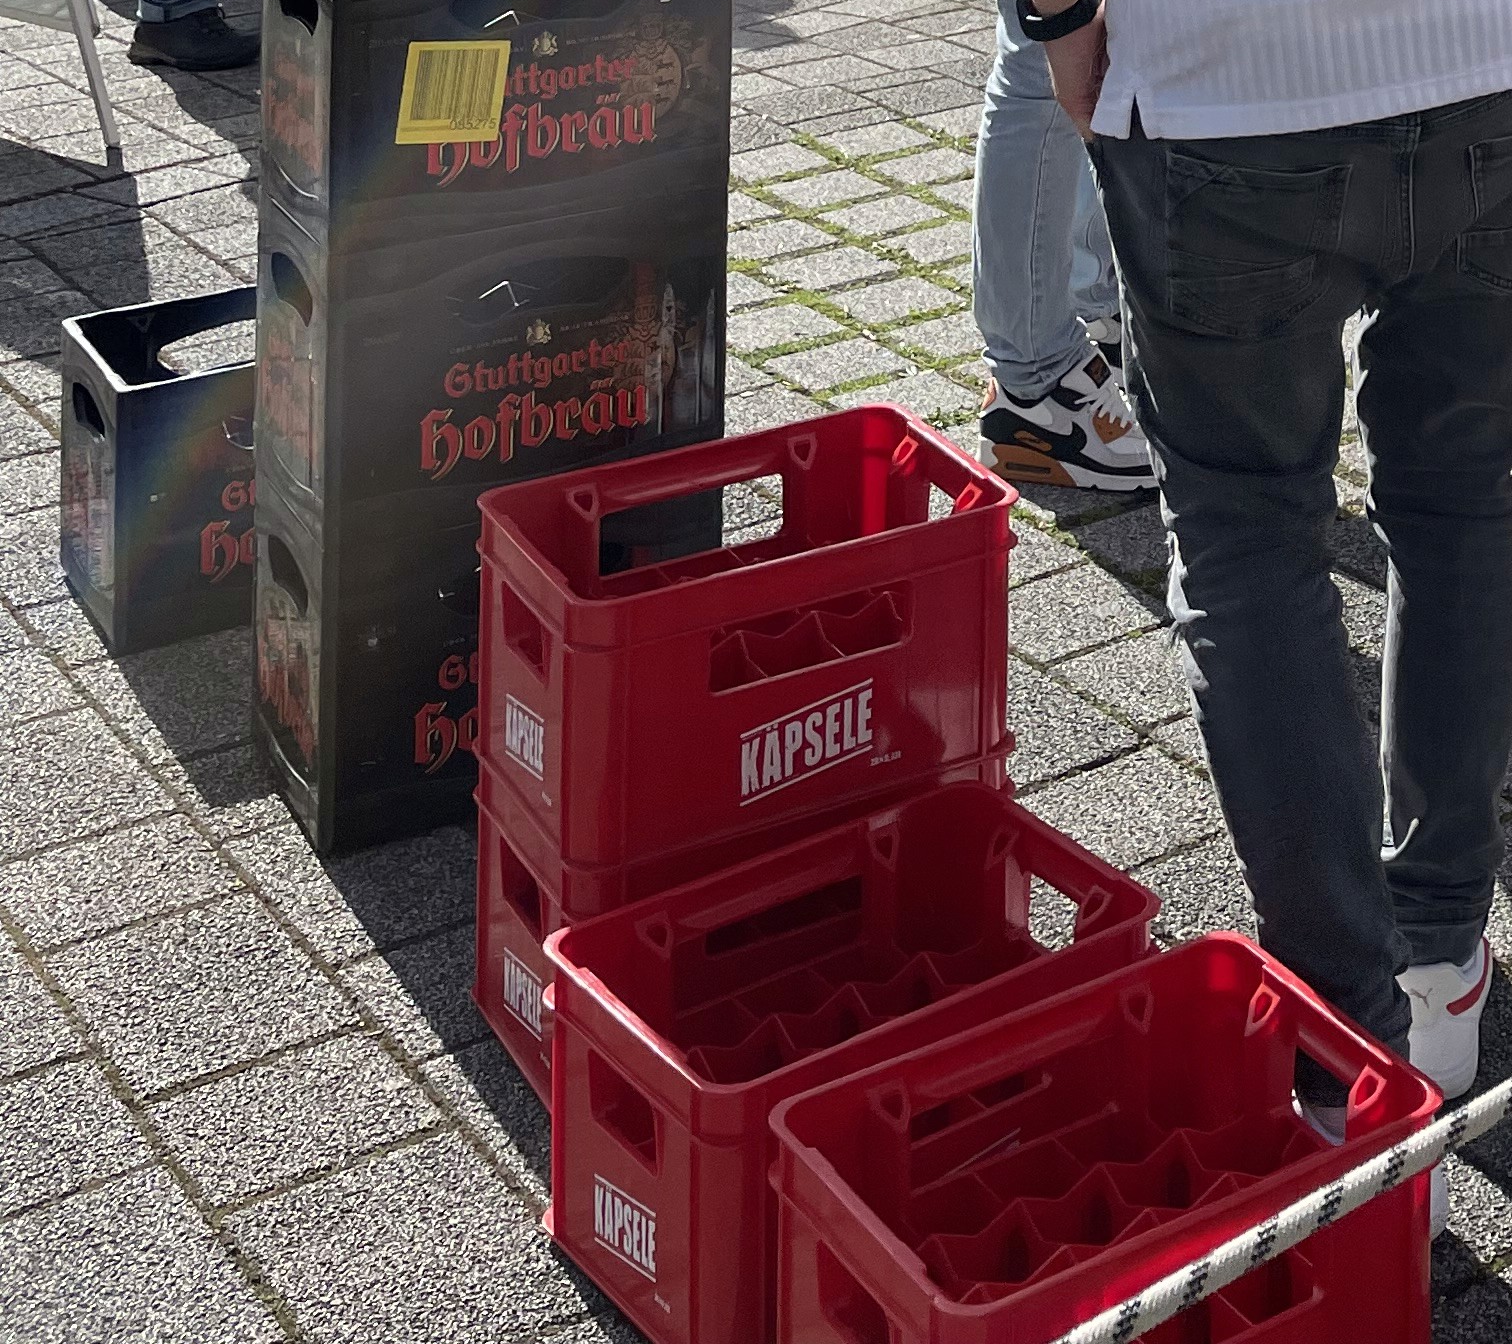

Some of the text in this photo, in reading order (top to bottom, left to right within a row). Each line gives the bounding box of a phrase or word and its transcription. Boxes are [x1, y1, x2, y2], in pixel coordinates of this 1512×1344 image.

[443, 338, 630, 399] Stuttgarter
[419, 377, 650, 481] Hofbräu
[741, 688, 872, 797] KÄPSELE
[594, 1183, 656, 1274] KÄPSELE
